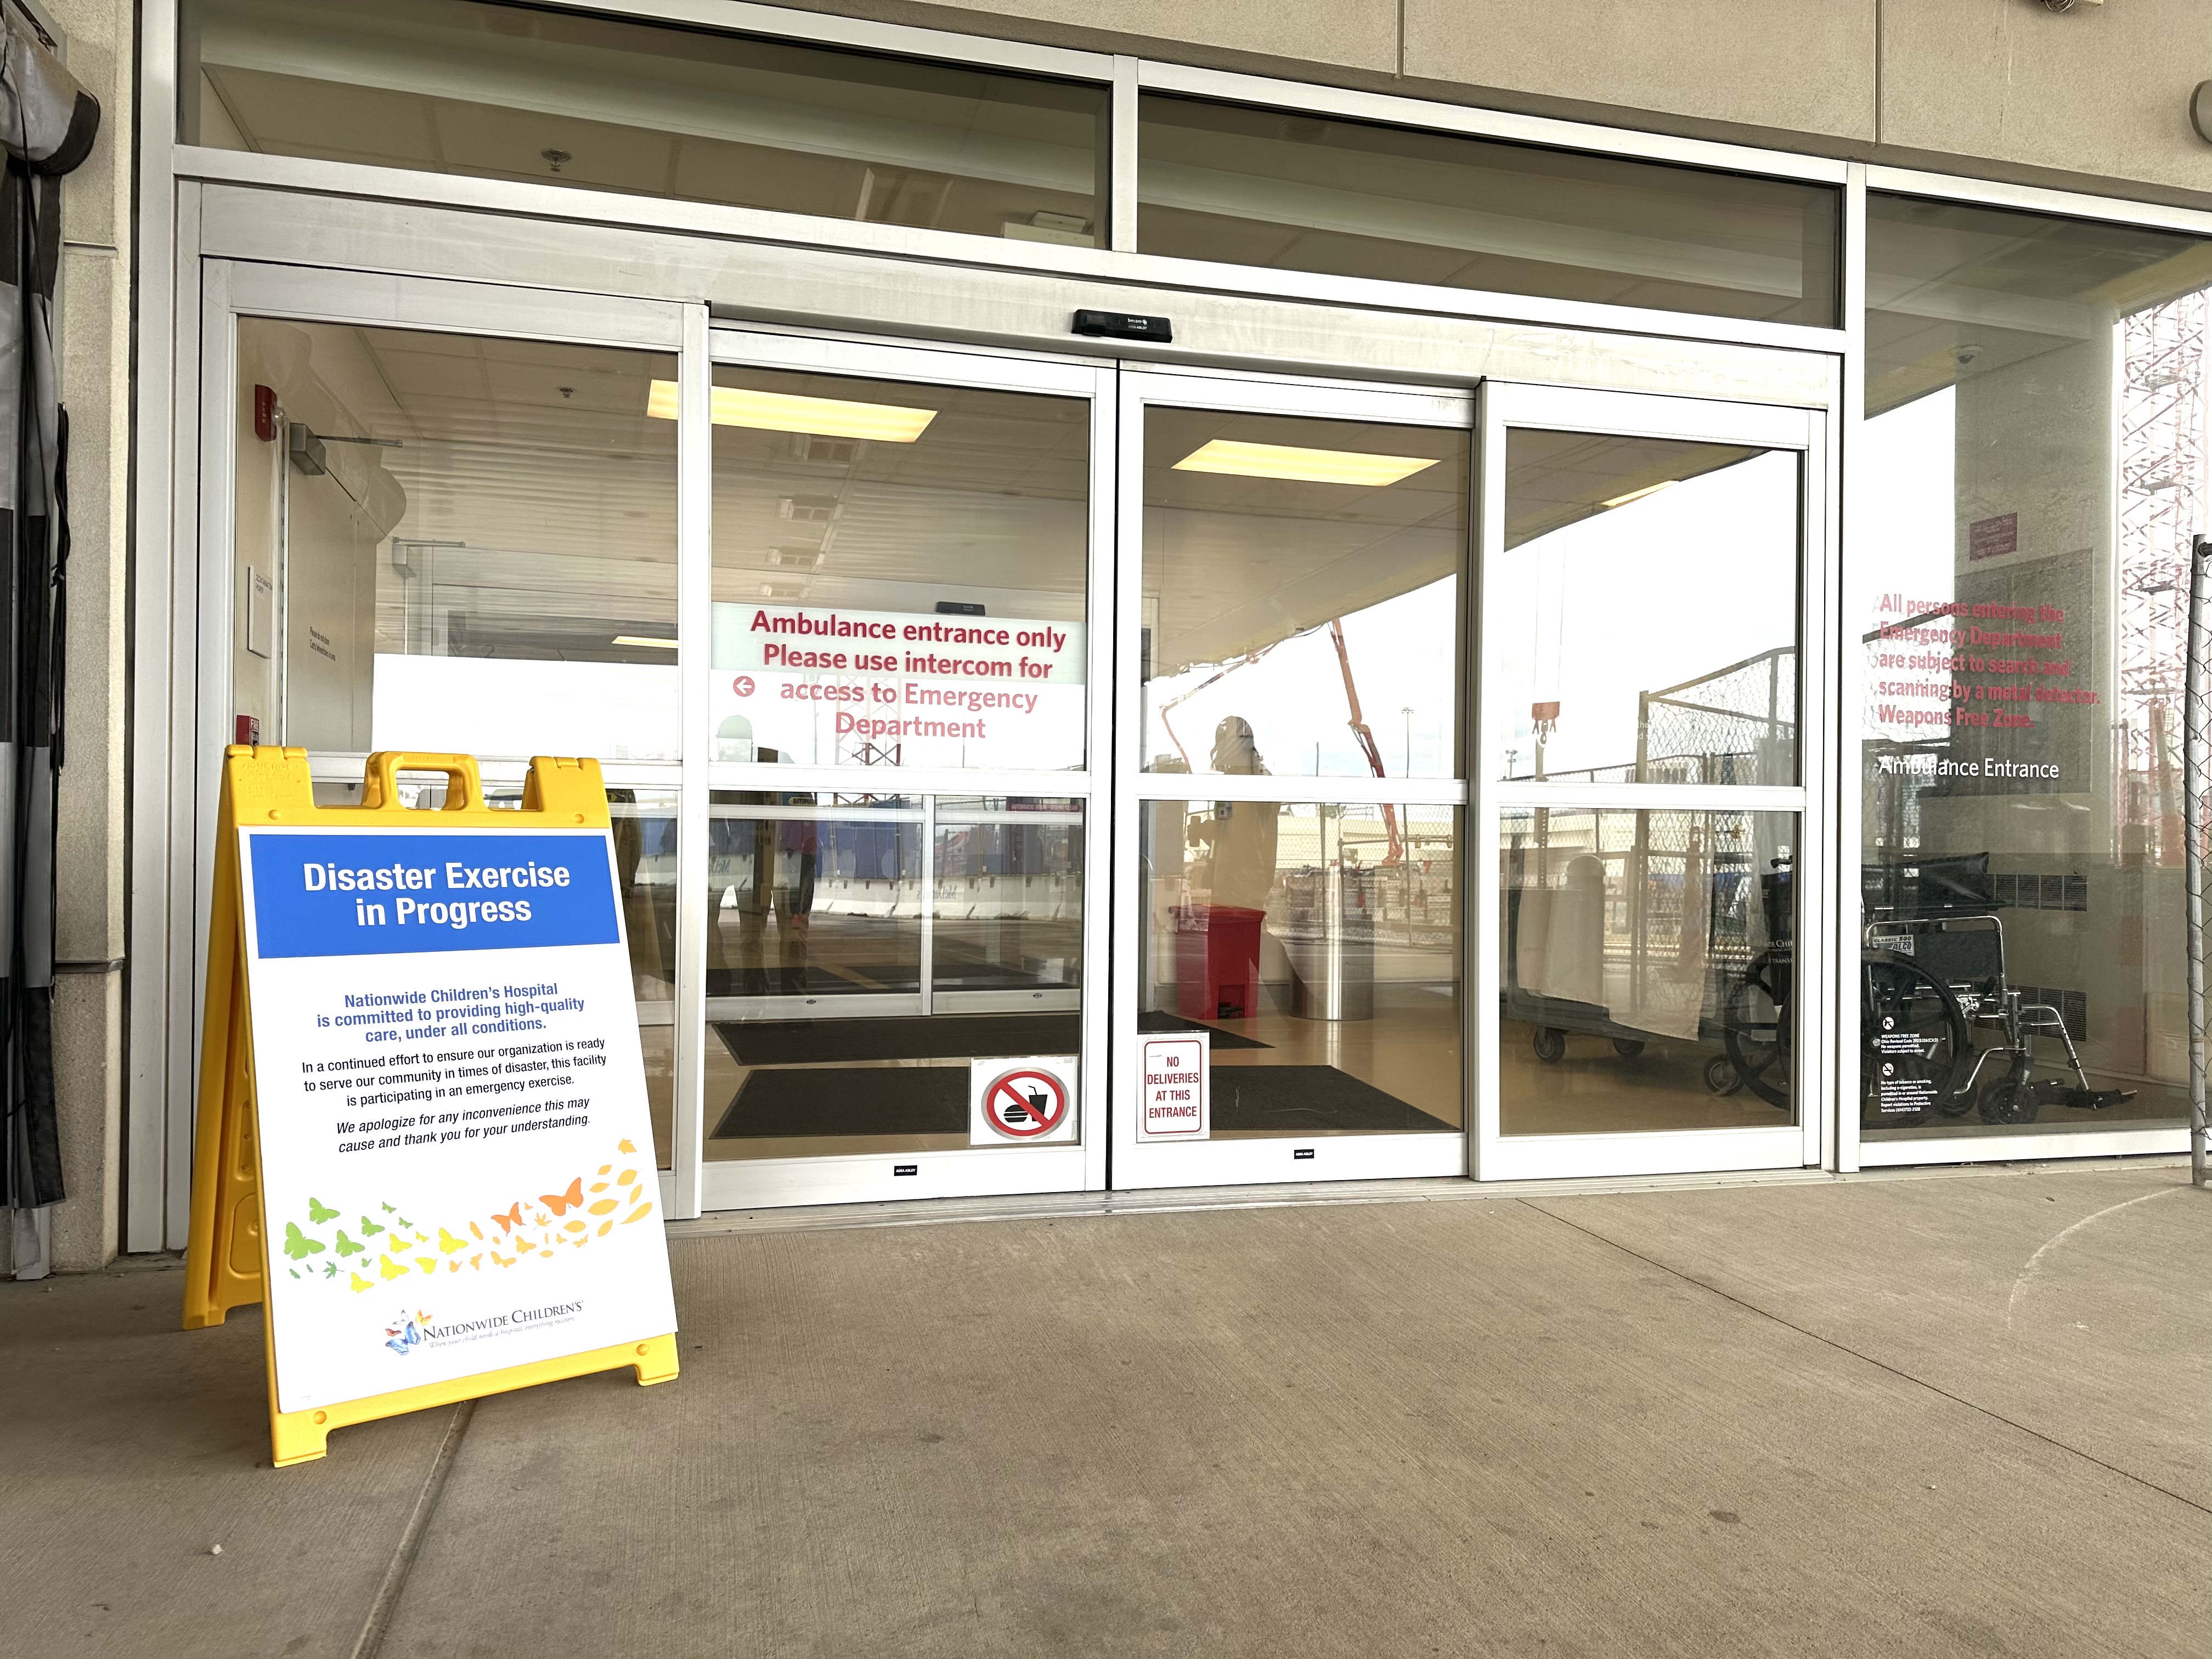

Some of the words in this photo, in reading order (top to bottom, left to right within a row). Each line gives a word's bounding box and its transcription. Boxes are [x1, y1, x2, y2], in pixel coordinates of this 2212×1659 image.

[1880, 594, 1901, 612] All
[1907, 600, 1968, 617] persons
[1972, 601, 2035, 624] entering
[2040, 604, 2064, 623] the
[751, 611, 895, 639] Ambulance
[904, 623, 1008, 645] entrance
[1017, 627, 1066, 652] only
[1880, 622, 1966, 647] Emergency
[1970, 627, 2062, 650] Department
[765, 644, 846, 668] Please
[855, 656, 897, 671] use
[906, 651, 1012, 676] intercom
[1020, 657, 1052, 678] for
[1880, 653, 1904, 668] are
[1909, 651, 1965, 674] subject
[1969, 655, 1984, 672] to
[1989, 657, 2039, 674] search
[2042, 659, 2069, 676] and
[780, 683, 864, 702] access
[872, 684, 896, 702] to
[906, 683, 1038, 713] Emergency
[1879, 678, 1949, 702] scanning
[1953, 680, 1971, 703] by
[1976, 685, 1984, 699] a
[1989, 684, 2030, 701] metal
[2035, 685, 2101, 704] detector.
[836, 712, 985, 738] Department
[1879, 704, 1951, 727] Weapons
[1956, 707, 1989, 726] Free
[1993, 709, 2035, 729] Zone.
[1878, 755, 1979, 776] Ambulance
[1984, 758, 2059, 778] Entrance
[304, 864, 436, 890] Disaster
[446, 862, 569, 888] Exercise
[356, 899, 386, 926] in
[396, 898, 531, 929] Progress
[345, 991, 426, 1007] Nationwide
[431, 987, 499, 1002] Children's
[504, 983, 557, 998] Hospital
[318, 1015, 330, 1027] is
[335, 1009, 413, 1026] committed
[417, 1009, 431, 1020] to
[436, 1005, 500, 1022] providing
[505, 998, 584, 1016] high-quality
[366, 1031, 401, 1042] care,
[406, 1025, 446, 1039] under
[452, 1023, 467, 1036] all
[472, 1019, 546, 1034] conditions.
[302, 1063, 313, 1073] In
[328, 1056, 385, 1071] continued
[390, 1054, 420, 1065] effort
[422, 1053, 433, 1063] to
[437, 1051, 473, 1062] ensure
[478, 1049, 495, 1058] our
[499, 1042, 562, 1058] organization
[566, 1041, 574, 1050] is
[578, 1038, 604, 1049] ready
[1167, 1057, 1179, 1067] NO
[304, 1081, 315, 1091] to
[320, 1080, 352, 1090] serve
[356, 1077, 375, 1087] our
[379, 1070, 441, 1085] community
[445, 1069, 455, 1079] in
[458, 1067, 488, 1077] times
[492, 1064, 501, 1074] of
[505, 1061, 549, 1073] disaster,
[551, 1059, 570, 1068] this
[573, 1055, 606, 1066] facility
[1148, 1073, 1199, 1084] DELIVERIES
[347, 1096, 357, 1106] is
[360, 1089, 432, 1107] participating
[436, 1087, 445, 1097] in
[449, 1087, 462, 1096] an
[466, 1081, 524, 1094] emergency
[529, 1075, 574, 1088] exercise.
[1156, 1091, 1167, 1101] AT
[1170, 1090, 1190, 1101] THIS
[337, 1122, 354, 1133] We
[359, 1116, 415, 1133] apologize
[420, 1114, 435, 1125] for
[439, 1113, 459, 1124] any
[462, 1104, 541, 1120] inconvenience
[545, 1099, 563, 1111] this
[568, 1099, 589, 1109] may
[1149, 1107, 1197, 1118] ENTRANCE
[339, 1141, 374, 1152] cause
[379, 1135, 400, 1148] and
[405, 1132, 437, 1145] thank
[440, 1131, 460, 1143] you
[465, 1127, 480, 1138] for
[483, 1125, 508, 1138] your
[511, 1115, 590, 1132] understanding.
[424, 1316, 508, 1340] NATIONWIDE
[512, 1302, 582, 1323] CHILDREN'S
